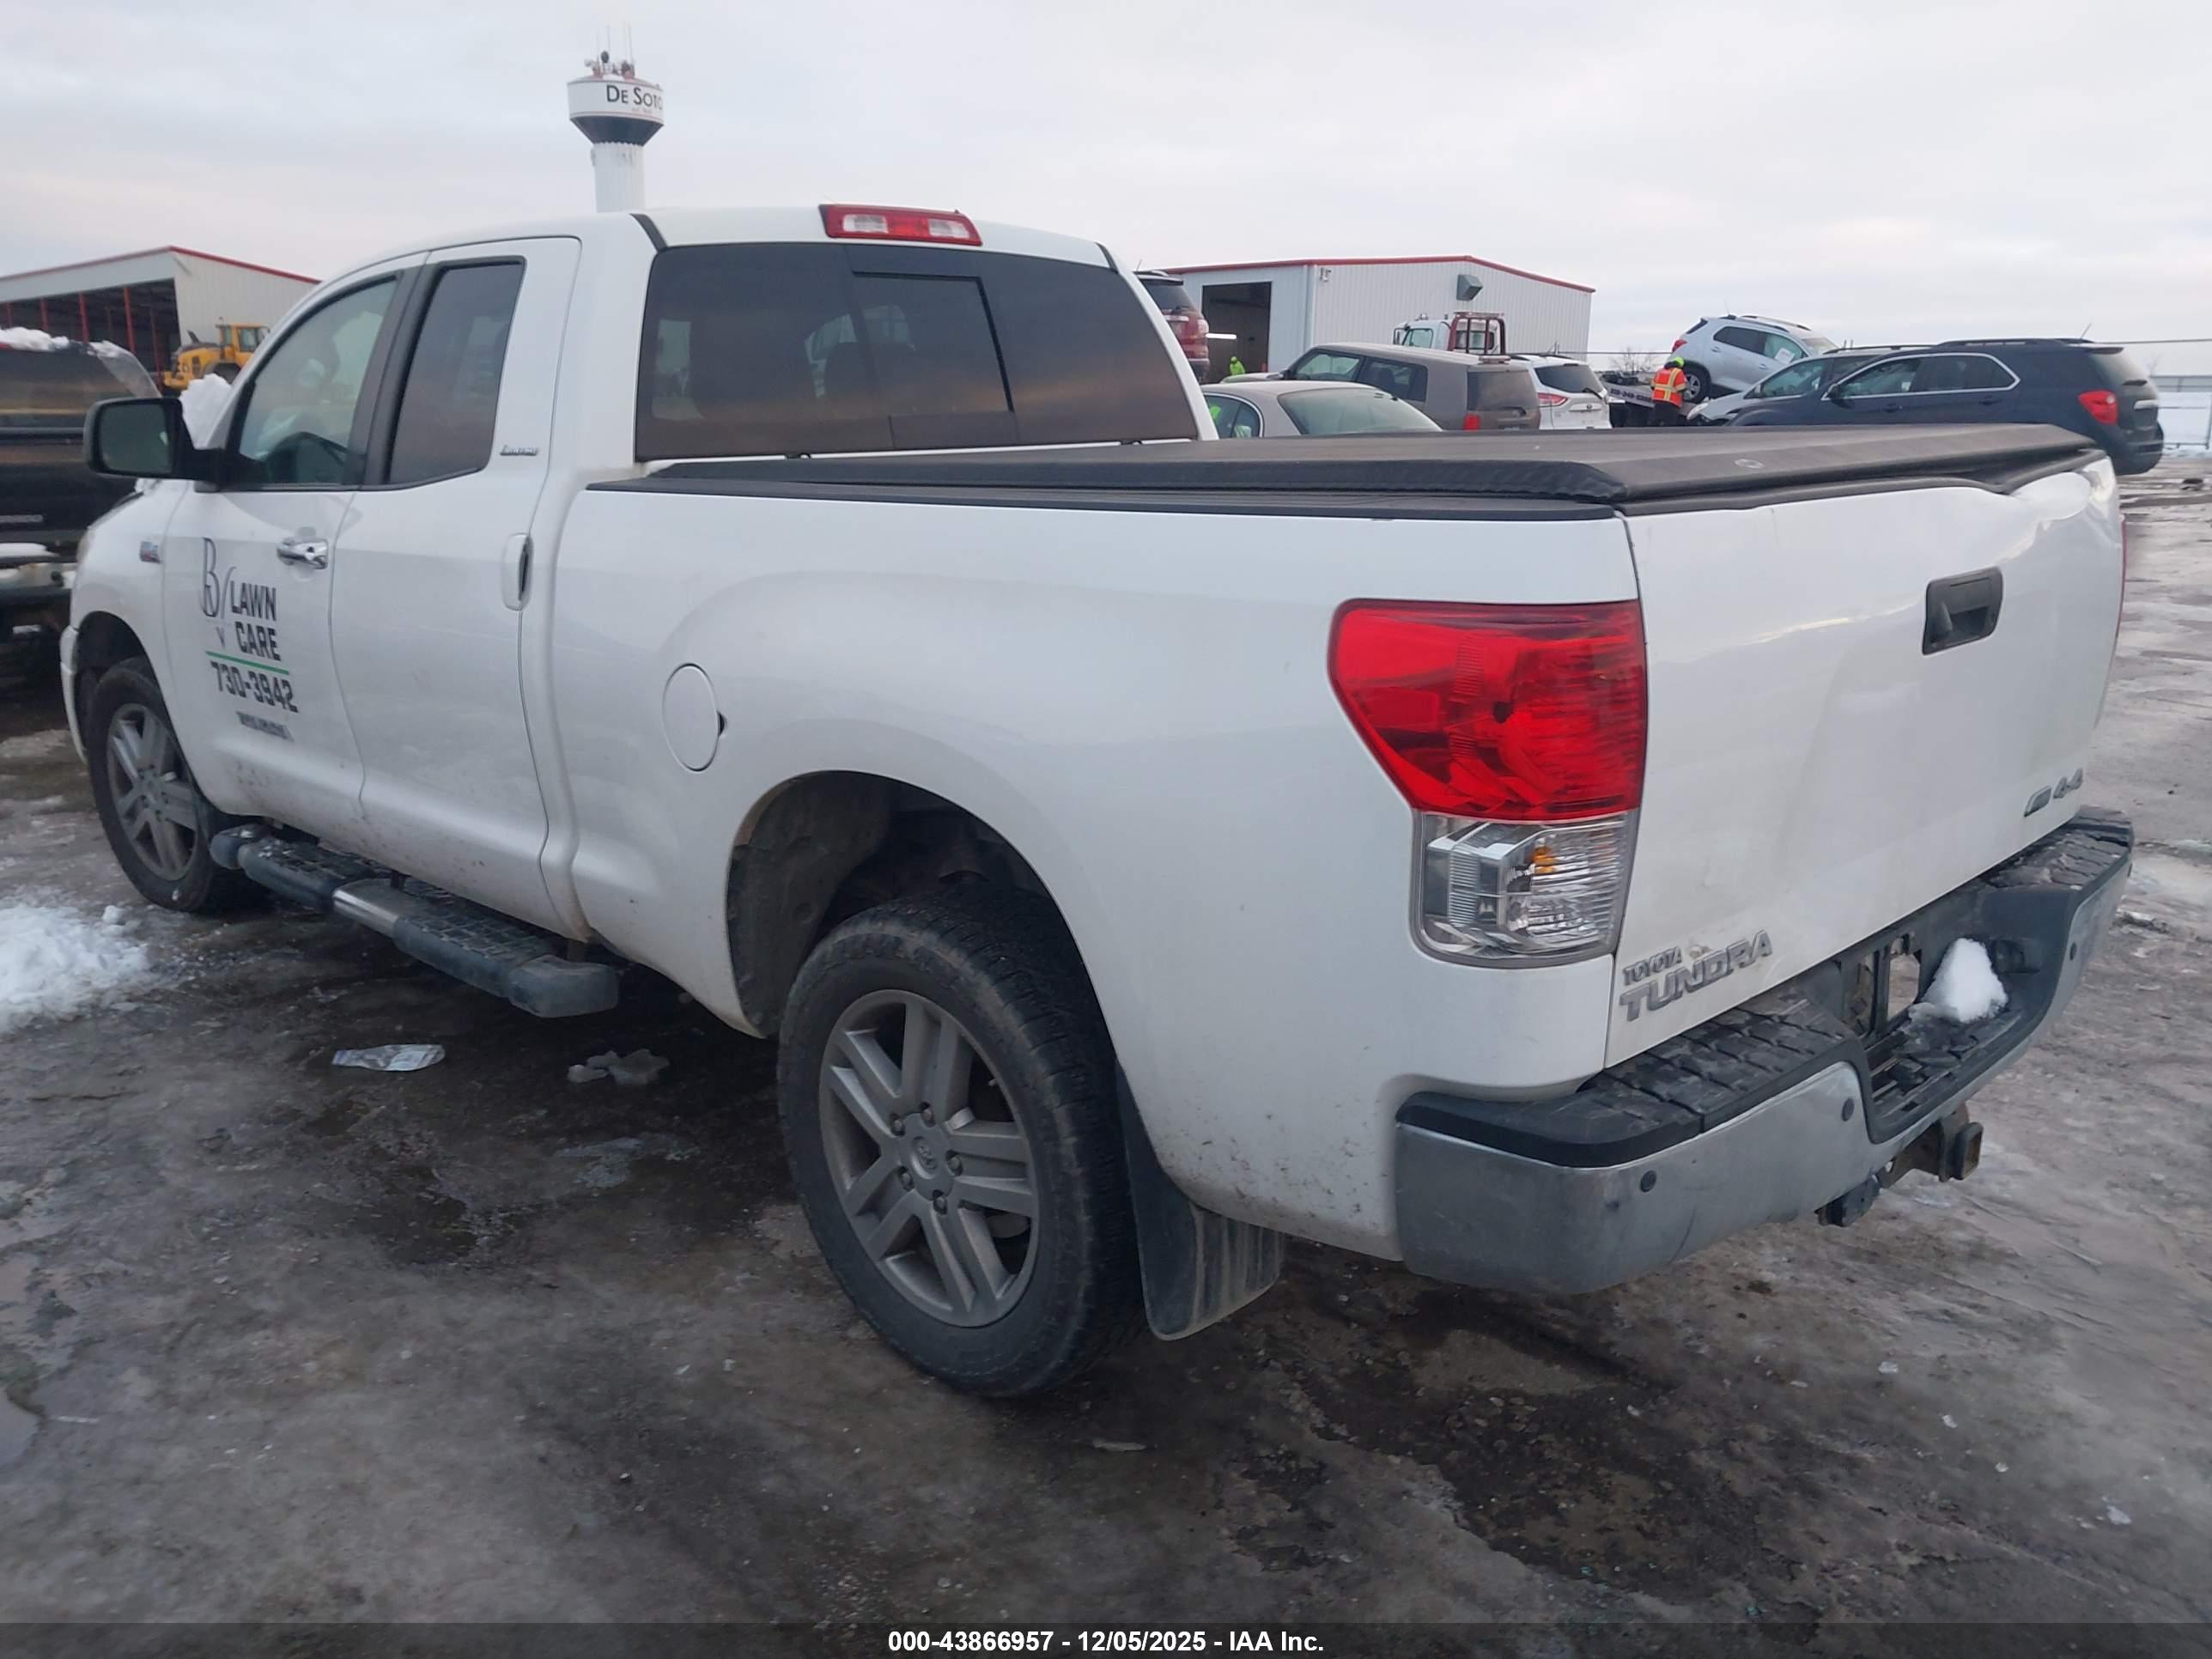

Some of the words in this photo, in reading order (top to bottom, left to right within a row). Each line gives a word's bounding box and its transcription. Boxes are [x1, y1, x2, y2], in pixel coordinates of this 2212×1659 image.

[230, 580, 276, 622] LAWN
[234, 621, 281, 661] CARE
[210, 659, 299, 713] 730-3942
[1619, 929, 1773, 1022] TUNDRA
[1622, 946, 1682, 986] TOYOTA
